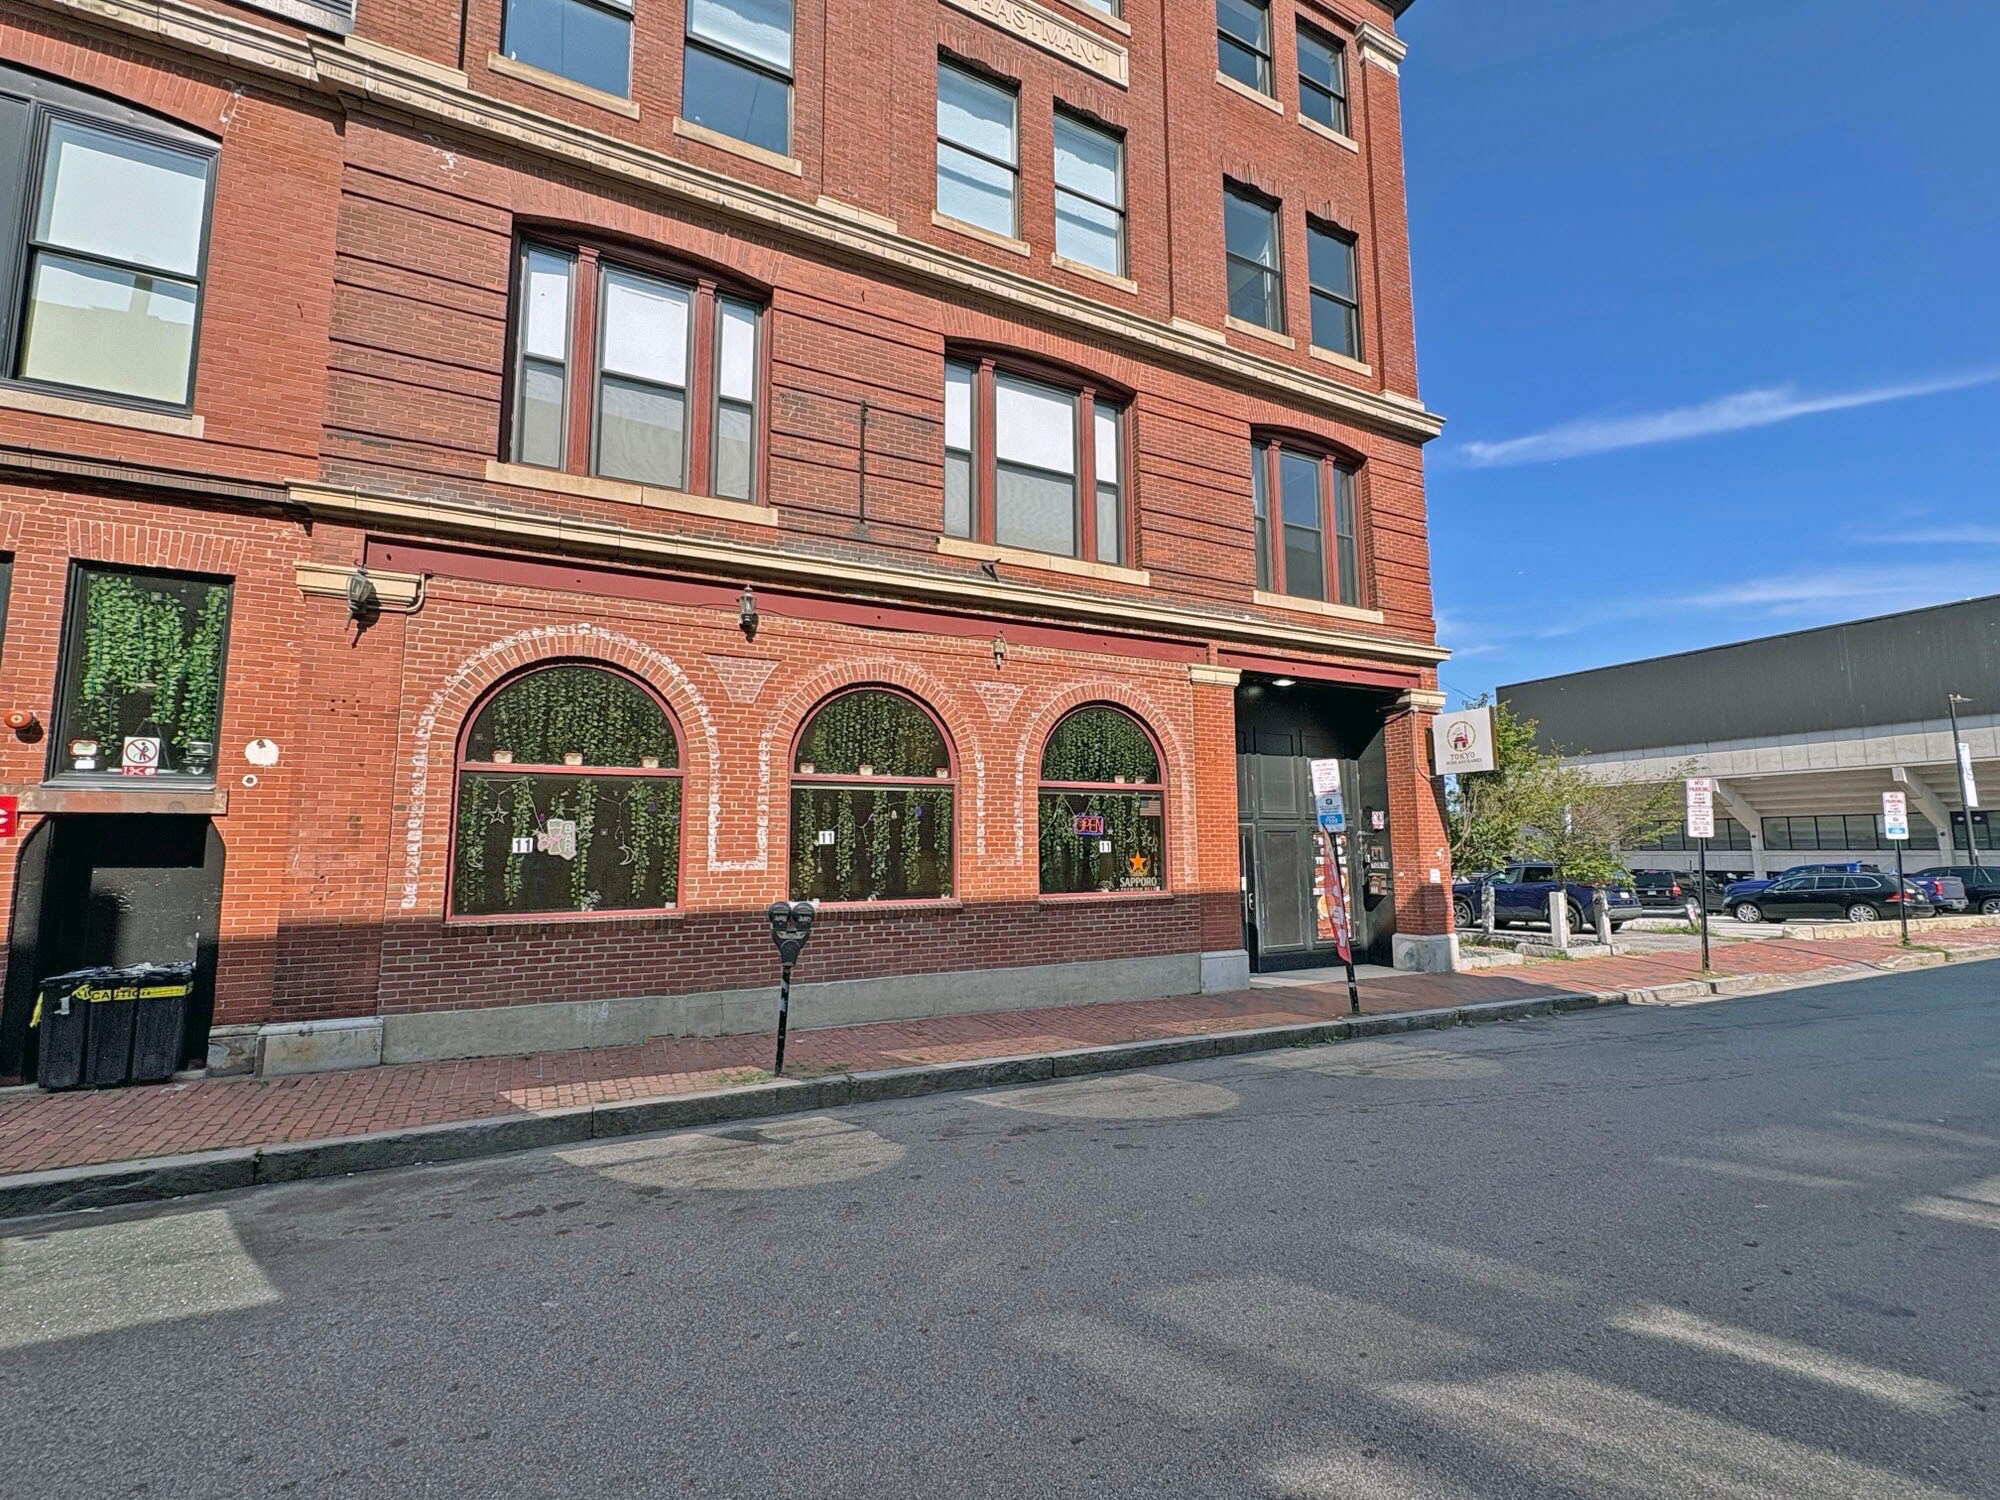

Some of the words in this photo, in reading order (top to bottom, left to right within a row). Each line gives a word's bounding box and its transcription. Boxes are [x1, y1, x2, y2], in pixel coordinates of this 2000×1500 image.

[1450, 752, 1475, 760] TOKYO
[1075, 818, 1101, 833] OPEN
[564, 824, 572, 852] BAR
[821, 832, 832, 843] 11
[515, 839, 531, 852] 11
[1101, 842, 1110, 852] 11
[1120, 877, 1157, 887] SAPPORO
